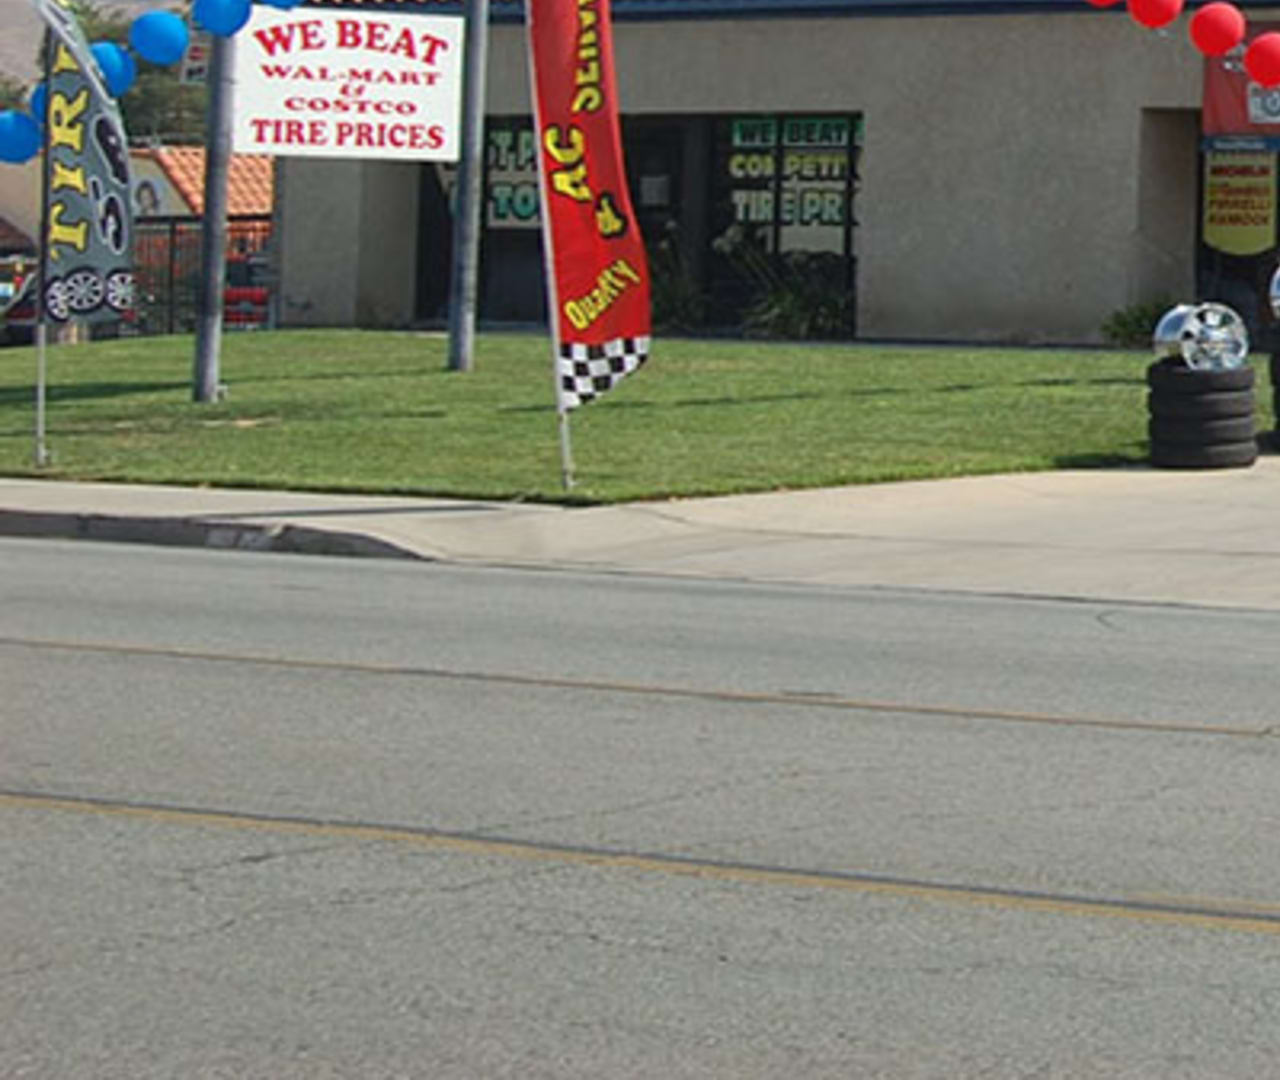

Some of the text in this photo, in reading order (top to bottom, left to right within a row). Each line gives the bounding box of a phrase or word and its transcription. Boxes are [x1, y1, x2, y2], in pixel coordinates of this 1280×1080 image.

[253, 20, 449, 66] WE BEAT
[260, 63, 442, 85] WAL-MART
[339, 84, 366, 97] &
[284, 97, 418, 116] COSTCO
[250, 119, 444, 150] TIRE PRICES
[739, 122, 846, 143] WE BEAT
[545, 125, 592, 202] AC
[732, 191, 793, 221] TIRE
